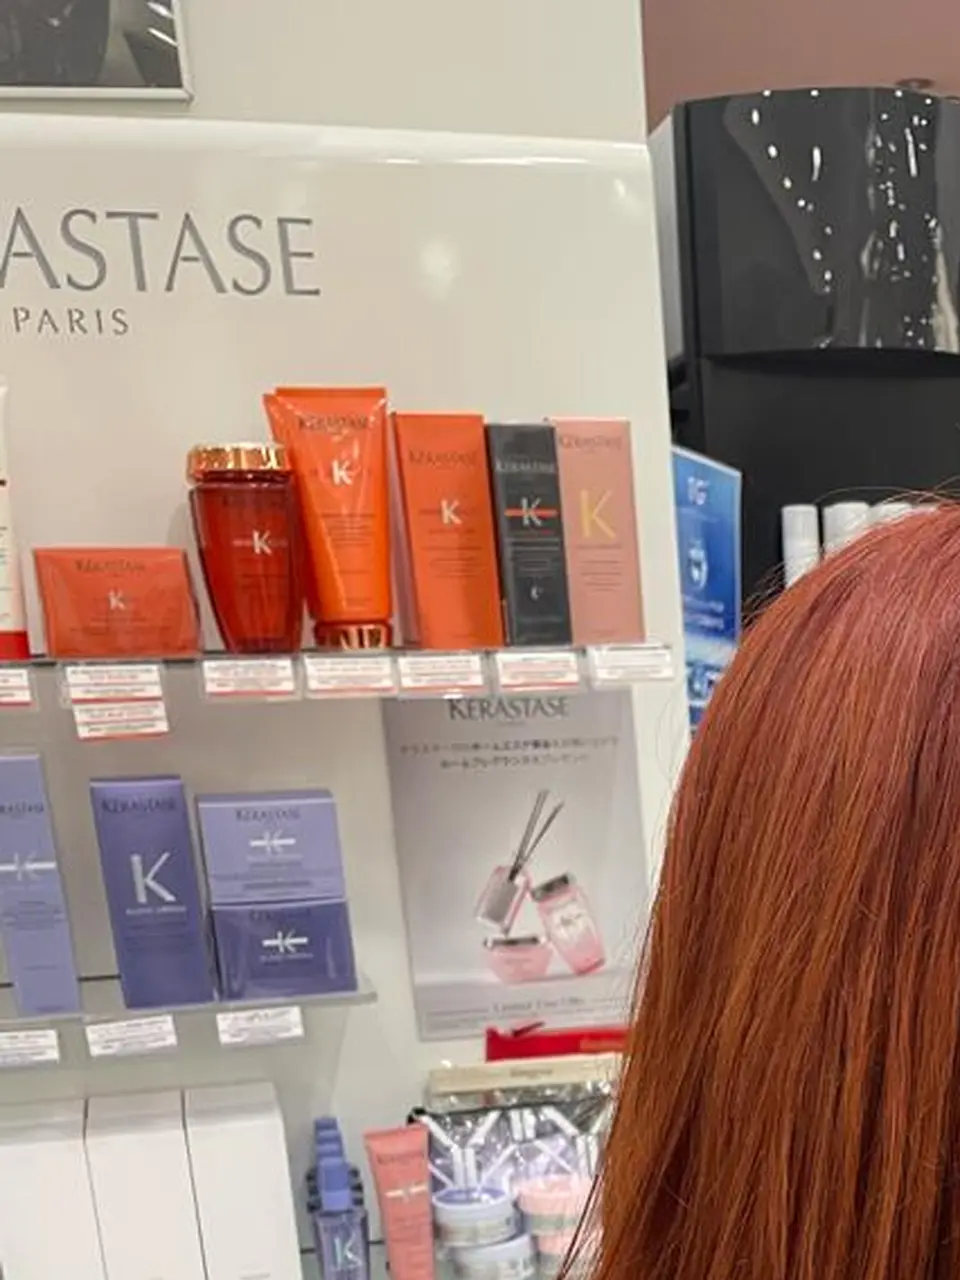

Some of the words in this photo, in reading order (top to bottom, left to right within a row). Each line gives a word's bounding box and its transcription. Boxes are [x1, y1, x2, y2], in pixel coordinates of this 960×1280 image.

[0, 206, 320, 296] ASTASE
[12, 306, 129, 336] PARIS
[332, 459, 353, 485] K
[440, 499, 462, 525] K
[521, 497, 542, 526] K
[579, 490, 616, 539] K
[252, 530, 271, 554] K
[108, 589, 127, 611] K
[130, 852, 176, 904] K
[334, 1234, 363, 1270] K
